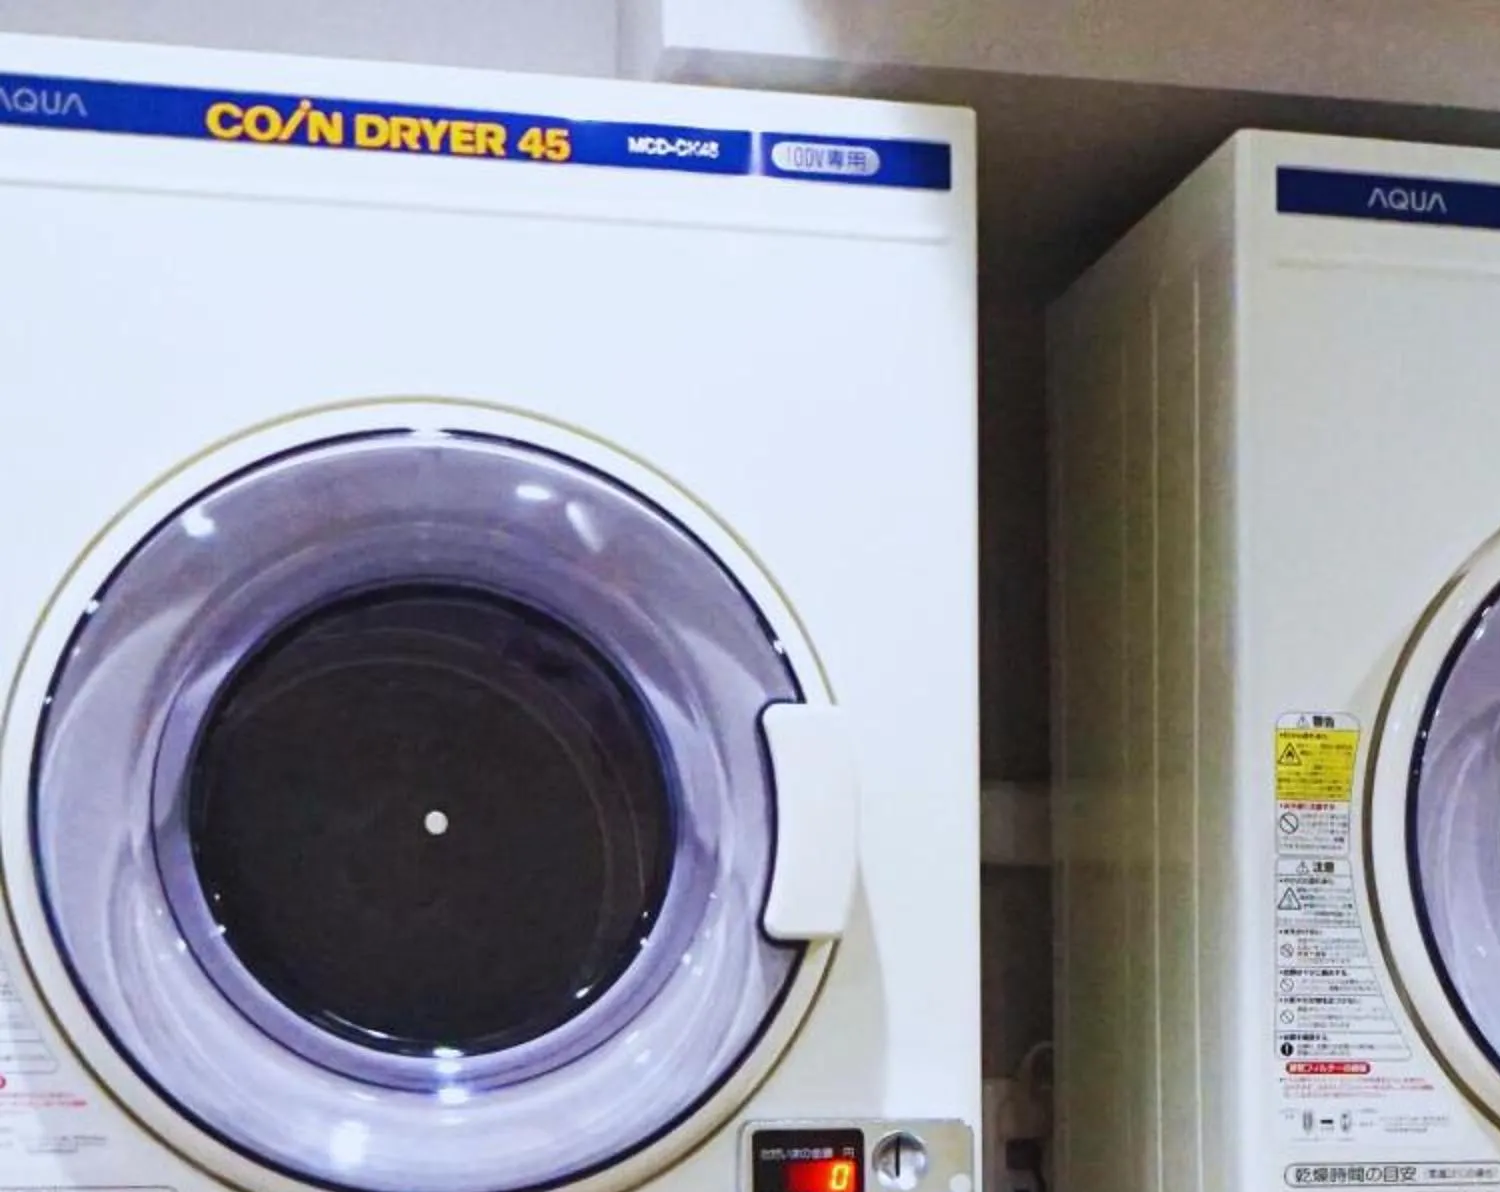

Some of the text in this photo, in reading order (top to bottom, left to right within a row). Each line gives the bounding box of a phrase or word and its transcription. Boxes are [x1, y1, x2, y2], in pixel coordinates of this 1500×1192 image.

[206, 99, 572, 161] COIN DRYER 45
[1367, 187, 1448, 214] AQUA
[831, 1162, 849, 1190] 0
